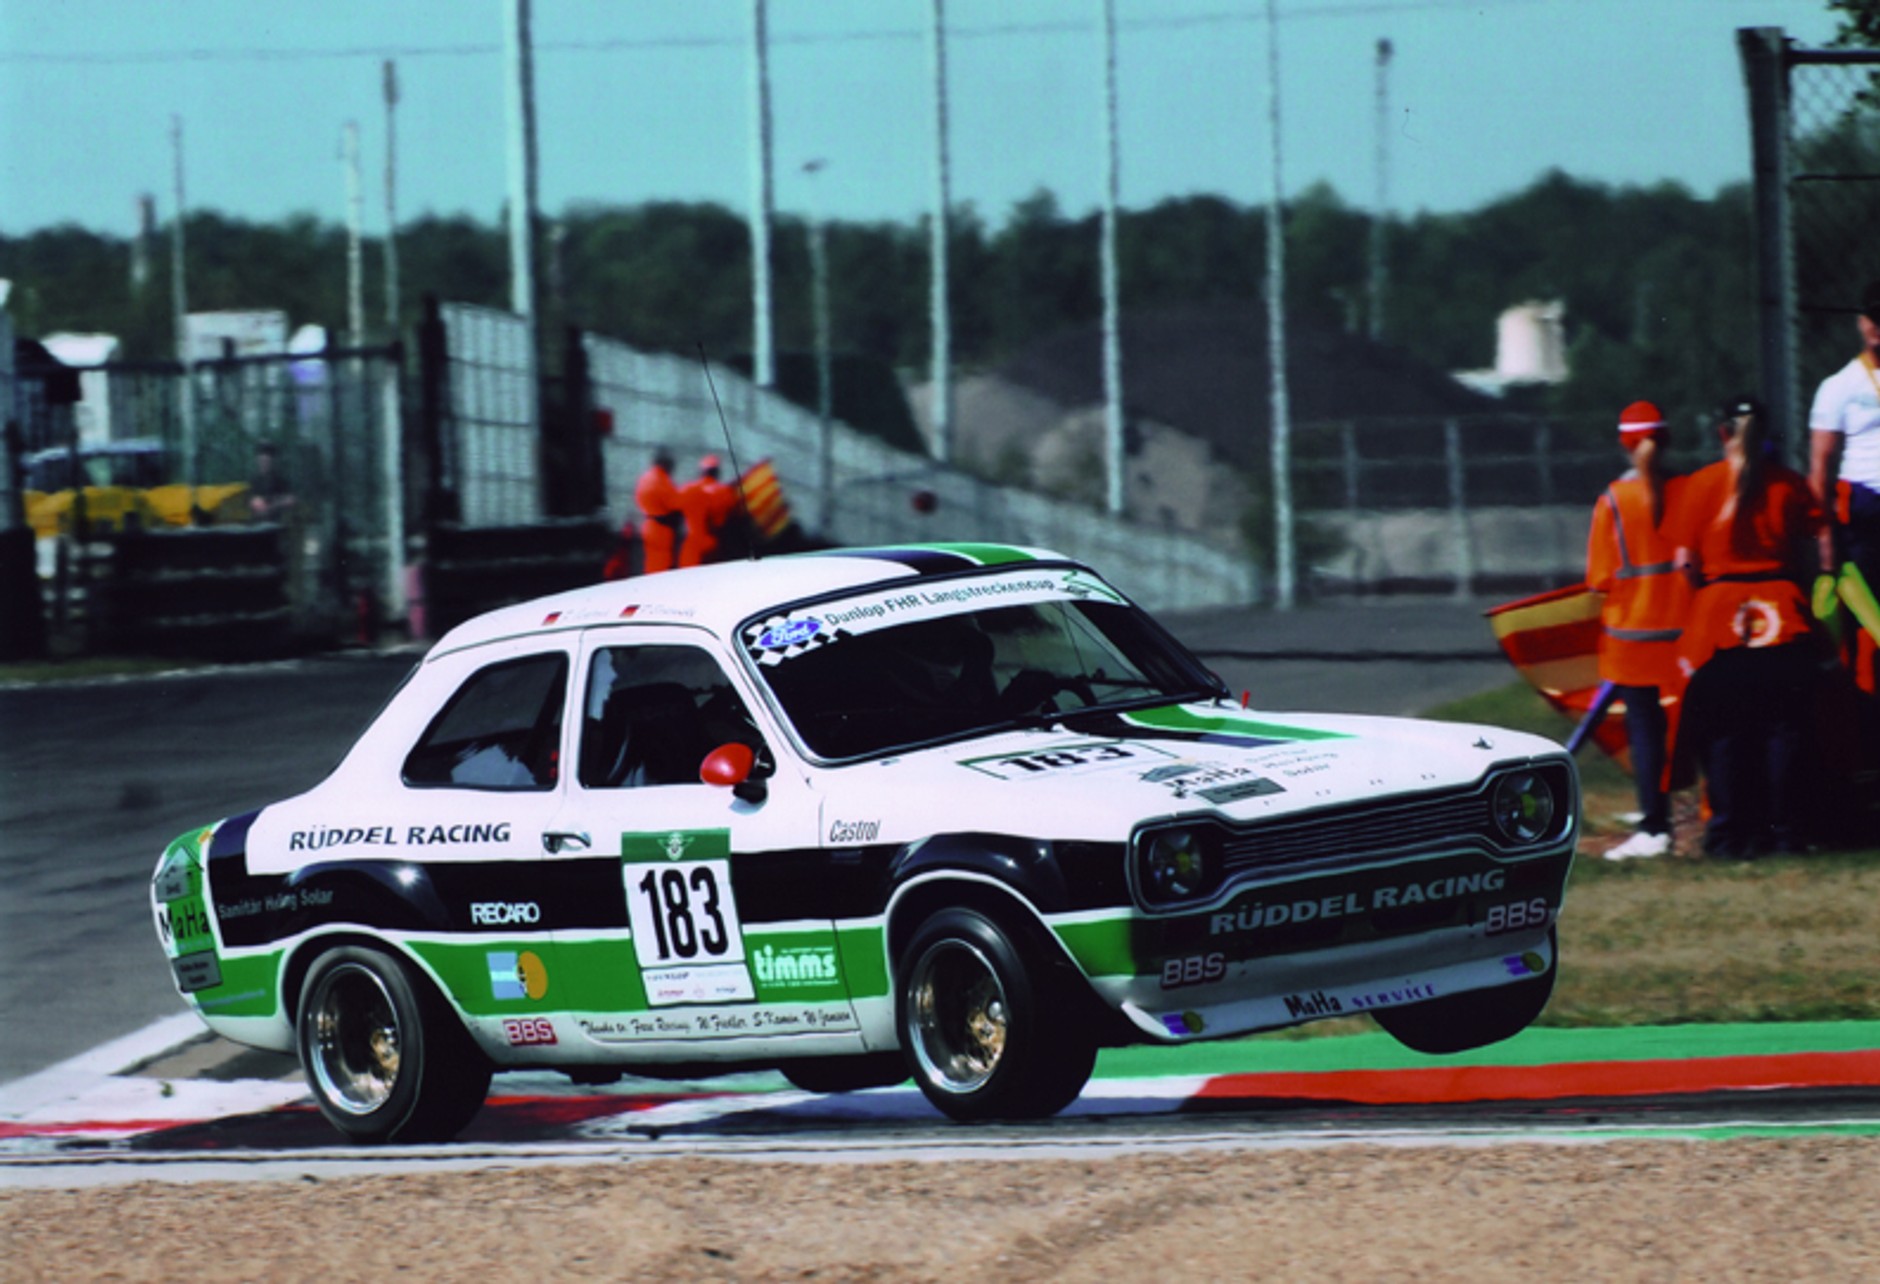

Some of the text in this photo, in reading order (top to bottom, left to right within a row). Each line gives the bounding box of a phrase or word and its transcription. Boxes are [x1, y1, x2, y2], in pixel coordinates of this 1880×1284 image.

[825, 603, 885, 626] Dunlop
[885, 592, 923, 613] FHR
[921, 578, 1055, 605] Langstreckencup
[1000, 746, 1135, 772] 183
[289, 822, 511, 851] RÜDDEL RACING
[830, 819, 881, 842] Castrol
[471, 902, 540, 925] RECARO
[639, 865, 729, 960] 183
[1210, 869, 1505, 935] RÜDDEL RACING
[1484, 898, 1550, 936] BBS
[158, 901, 211, 943] MaHa
[754, 944, 836, 982] timms
[1160, 952, 1227, 990] BBS
[1282, 991, 1344, 1018] MaHa
[503, 1017, 559, 1046] BBS
